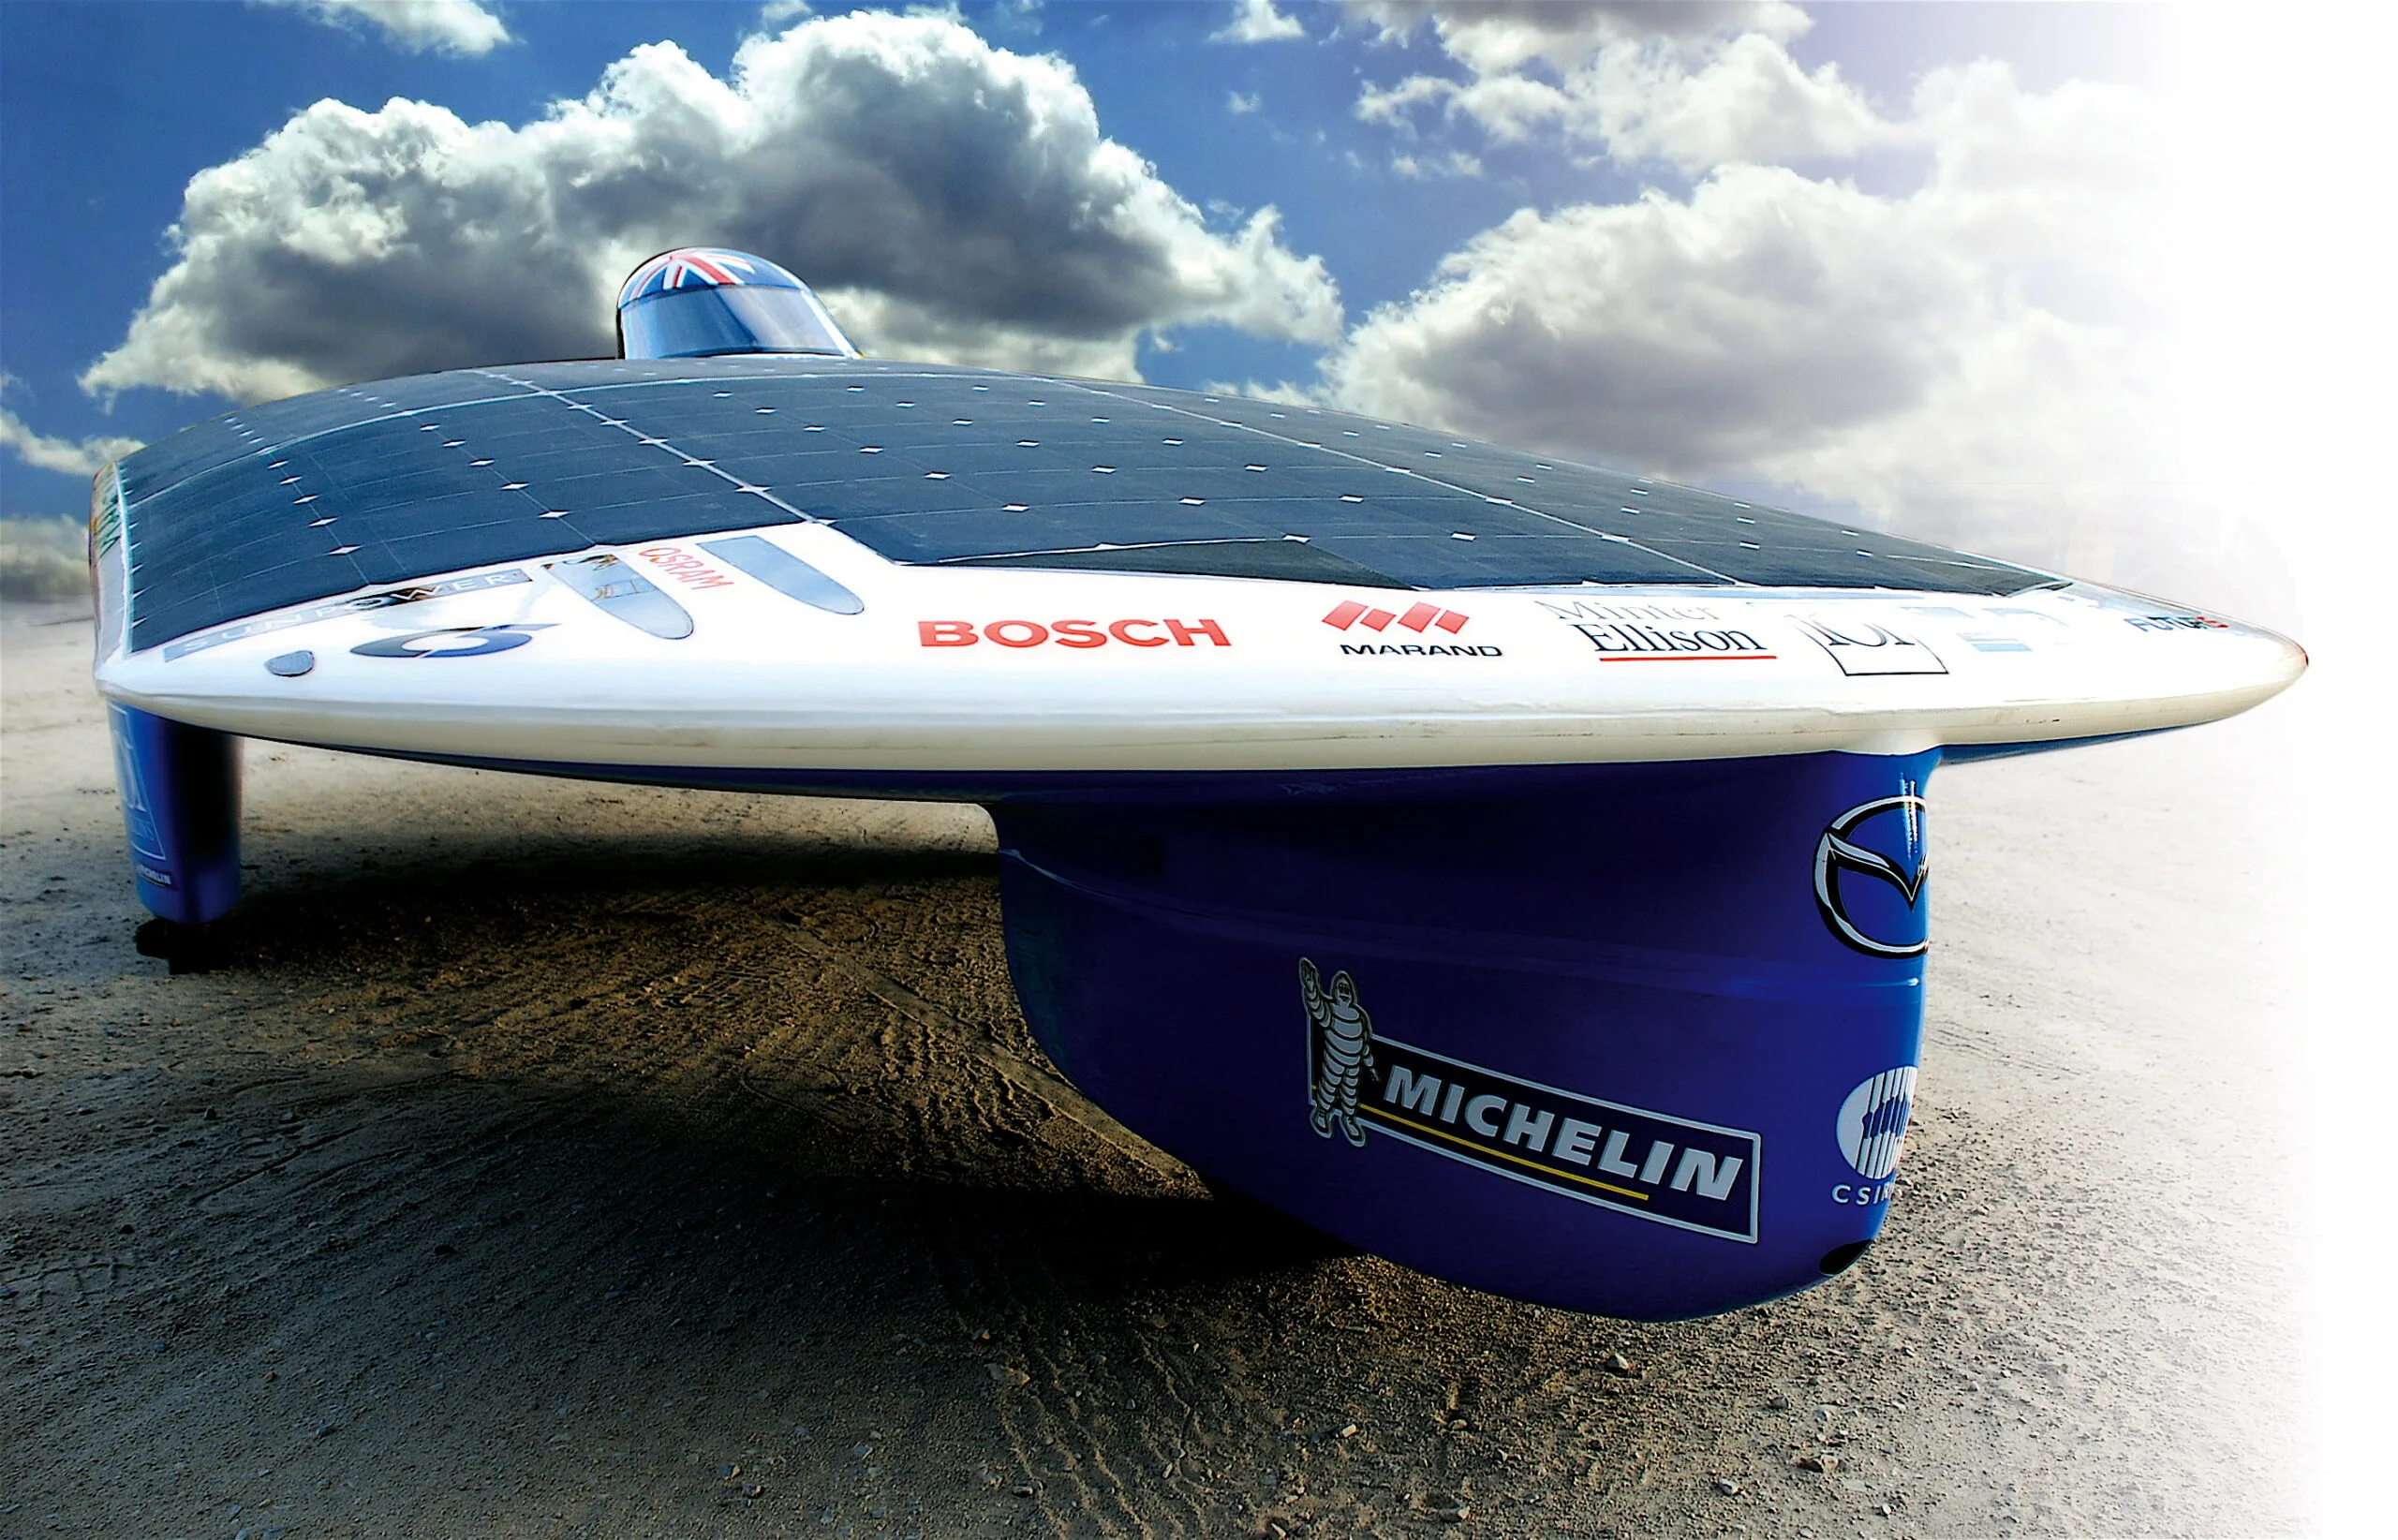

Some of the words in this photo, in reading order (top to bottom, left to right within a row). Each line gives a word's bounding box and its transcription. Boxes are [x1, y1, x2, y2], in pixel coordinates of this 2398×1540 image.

[638, 547, 735, 590] OSRAM
[917, 618, 1232, 648] BOSCH
[1567, 623, 1769, 652] Ellison
[1339, 644, 1503, 657] MARAND
[1383, 1063, 1743, 1201] MICHELIN
[1831, 1181, 1893, 1207] CSIR
